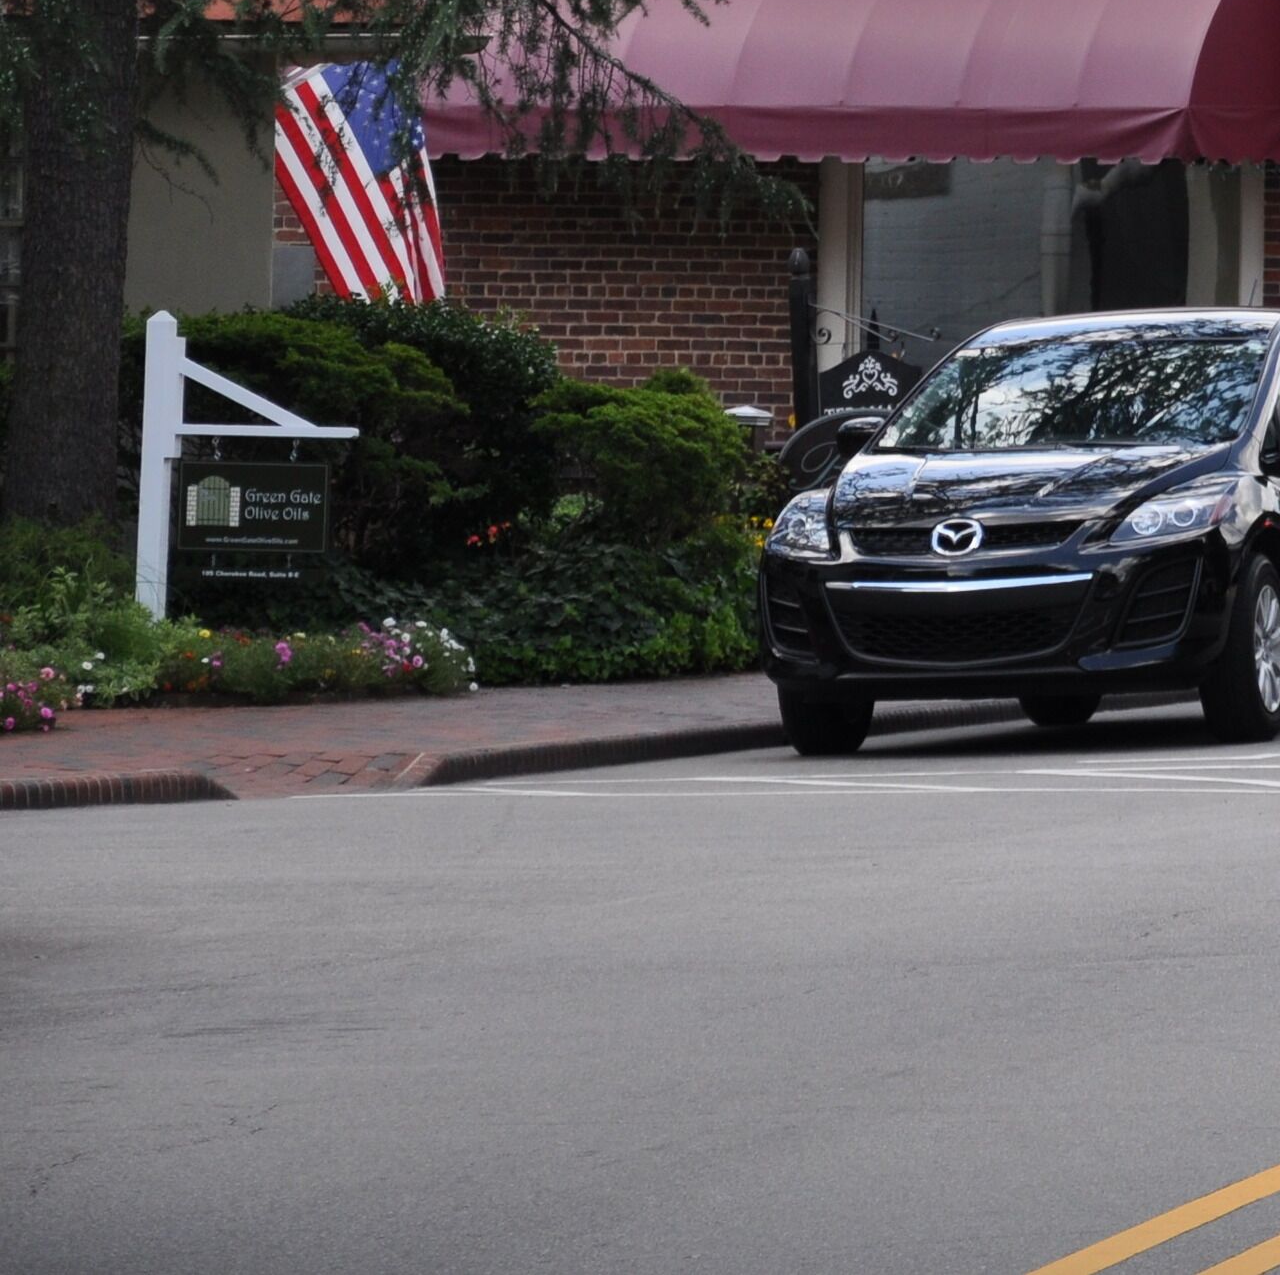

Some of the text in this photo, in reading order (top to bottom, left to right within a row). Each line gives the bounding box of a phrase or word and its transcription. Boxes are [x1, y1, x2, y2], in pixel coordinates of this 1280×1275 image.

[245, 488, 322, 504] Green Gate
[244, 506, 310, 521] Olive Oils
